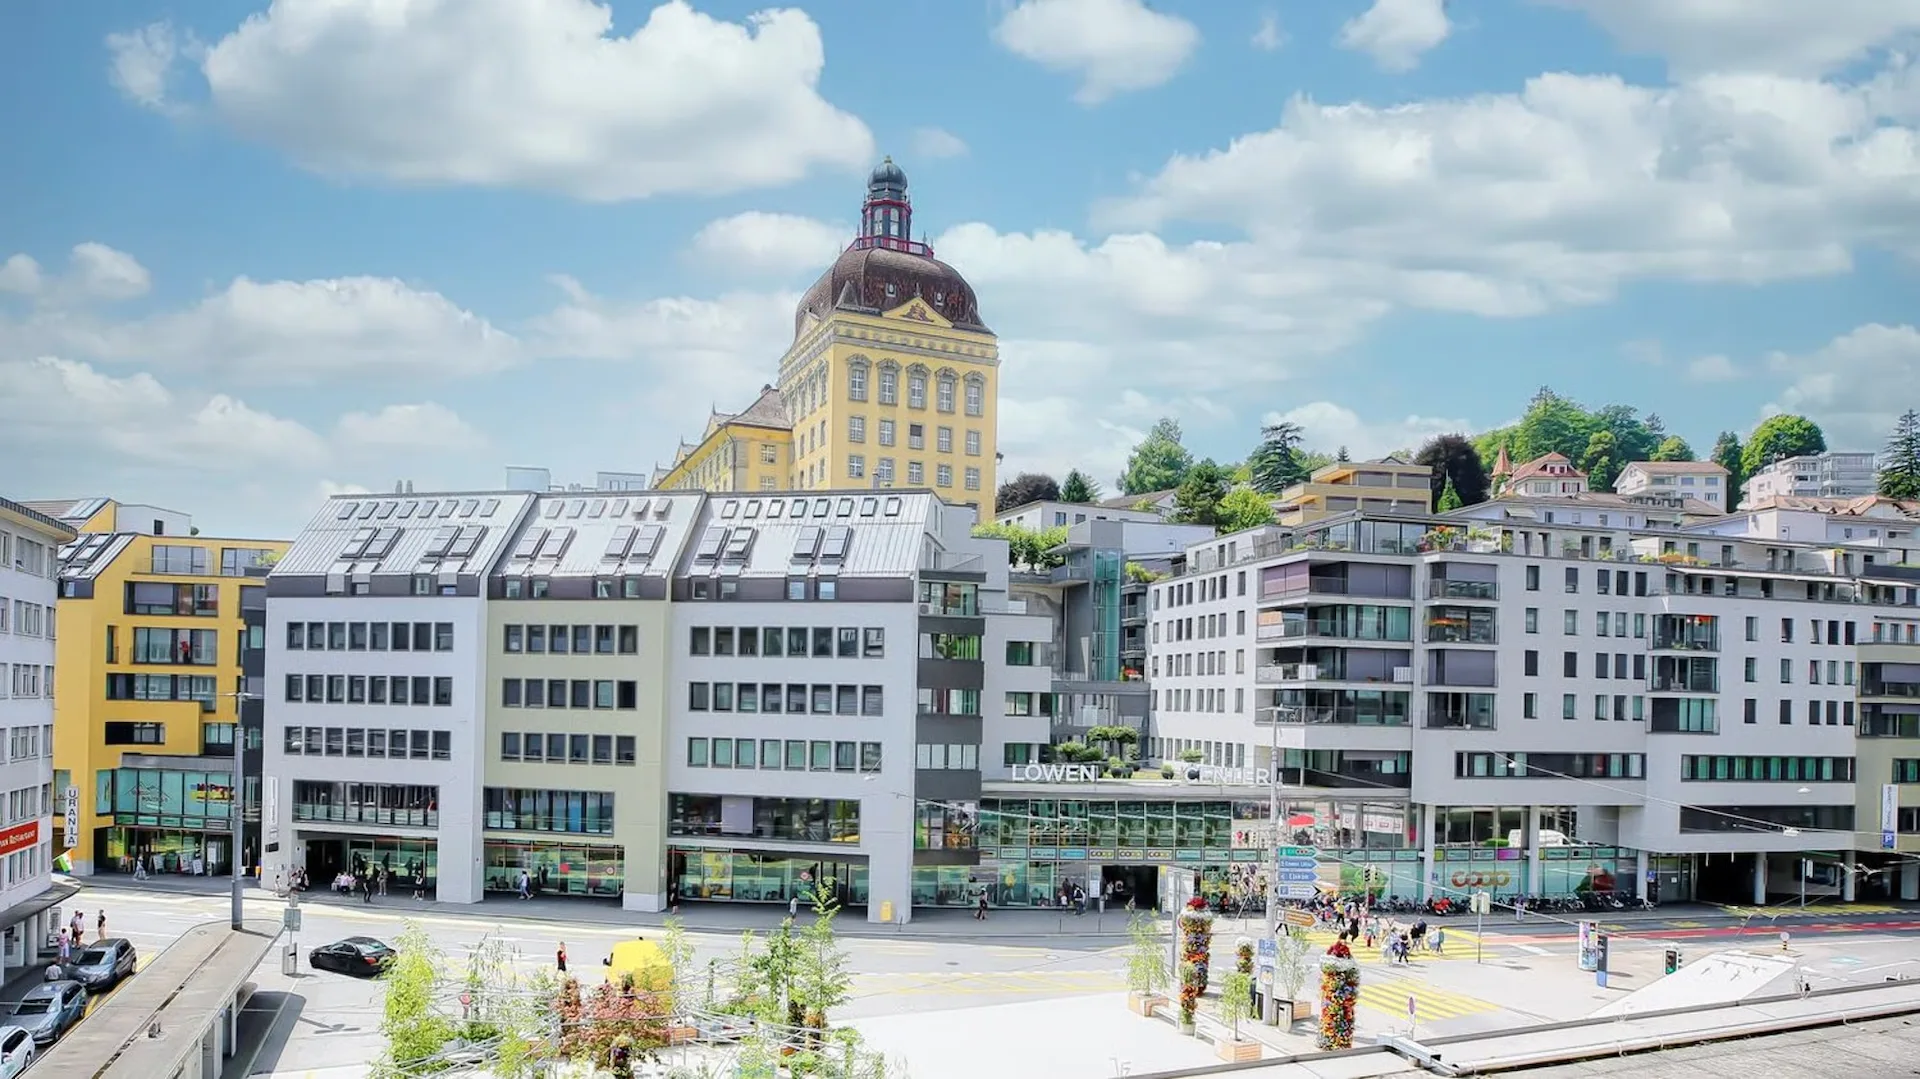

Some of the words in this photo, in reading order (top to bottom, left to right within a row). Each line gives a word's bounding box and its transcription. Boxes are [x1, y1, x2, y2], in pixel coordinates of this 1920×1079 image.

[1012, 760, 1095, 782] LÖWEN
[1185, 767, 1272, 786] CENTER
[68, 789, 76, 844] URANIA
